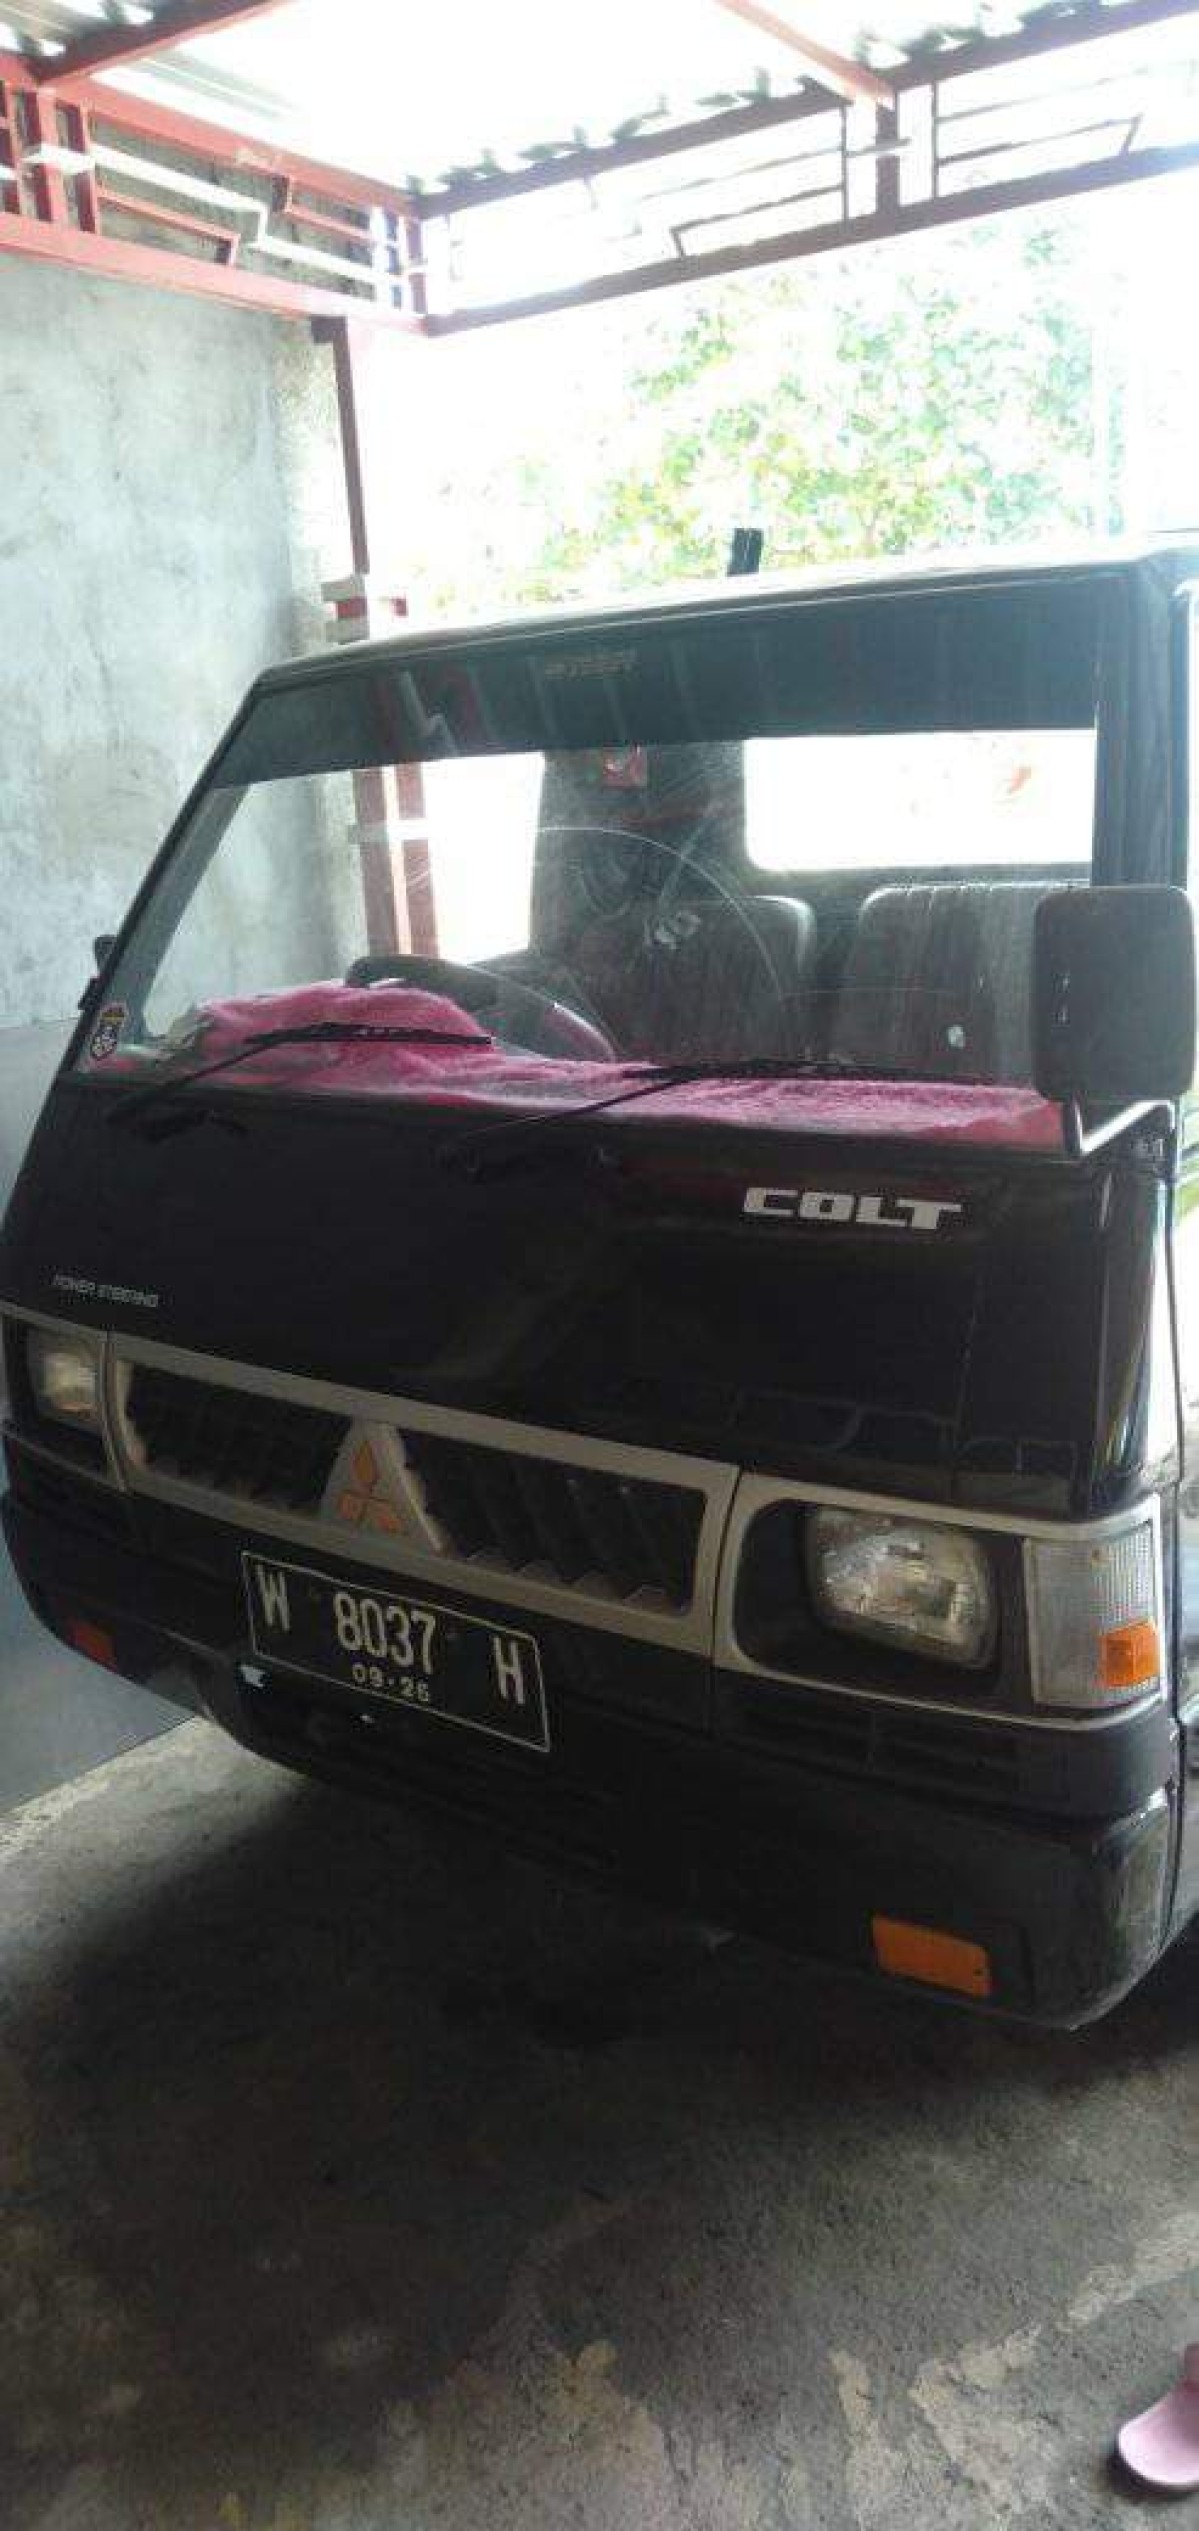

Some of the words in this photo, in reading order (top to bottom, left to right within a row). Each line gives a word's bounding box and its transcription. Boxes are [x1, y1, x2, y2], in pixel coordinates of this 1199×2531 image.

[743, 1187, 962, 1229] COLT
[255, 1564, 291, 1632] W
[333, 1591, 436, 1675] 8037
[493, 1637, 525, 1705] H
